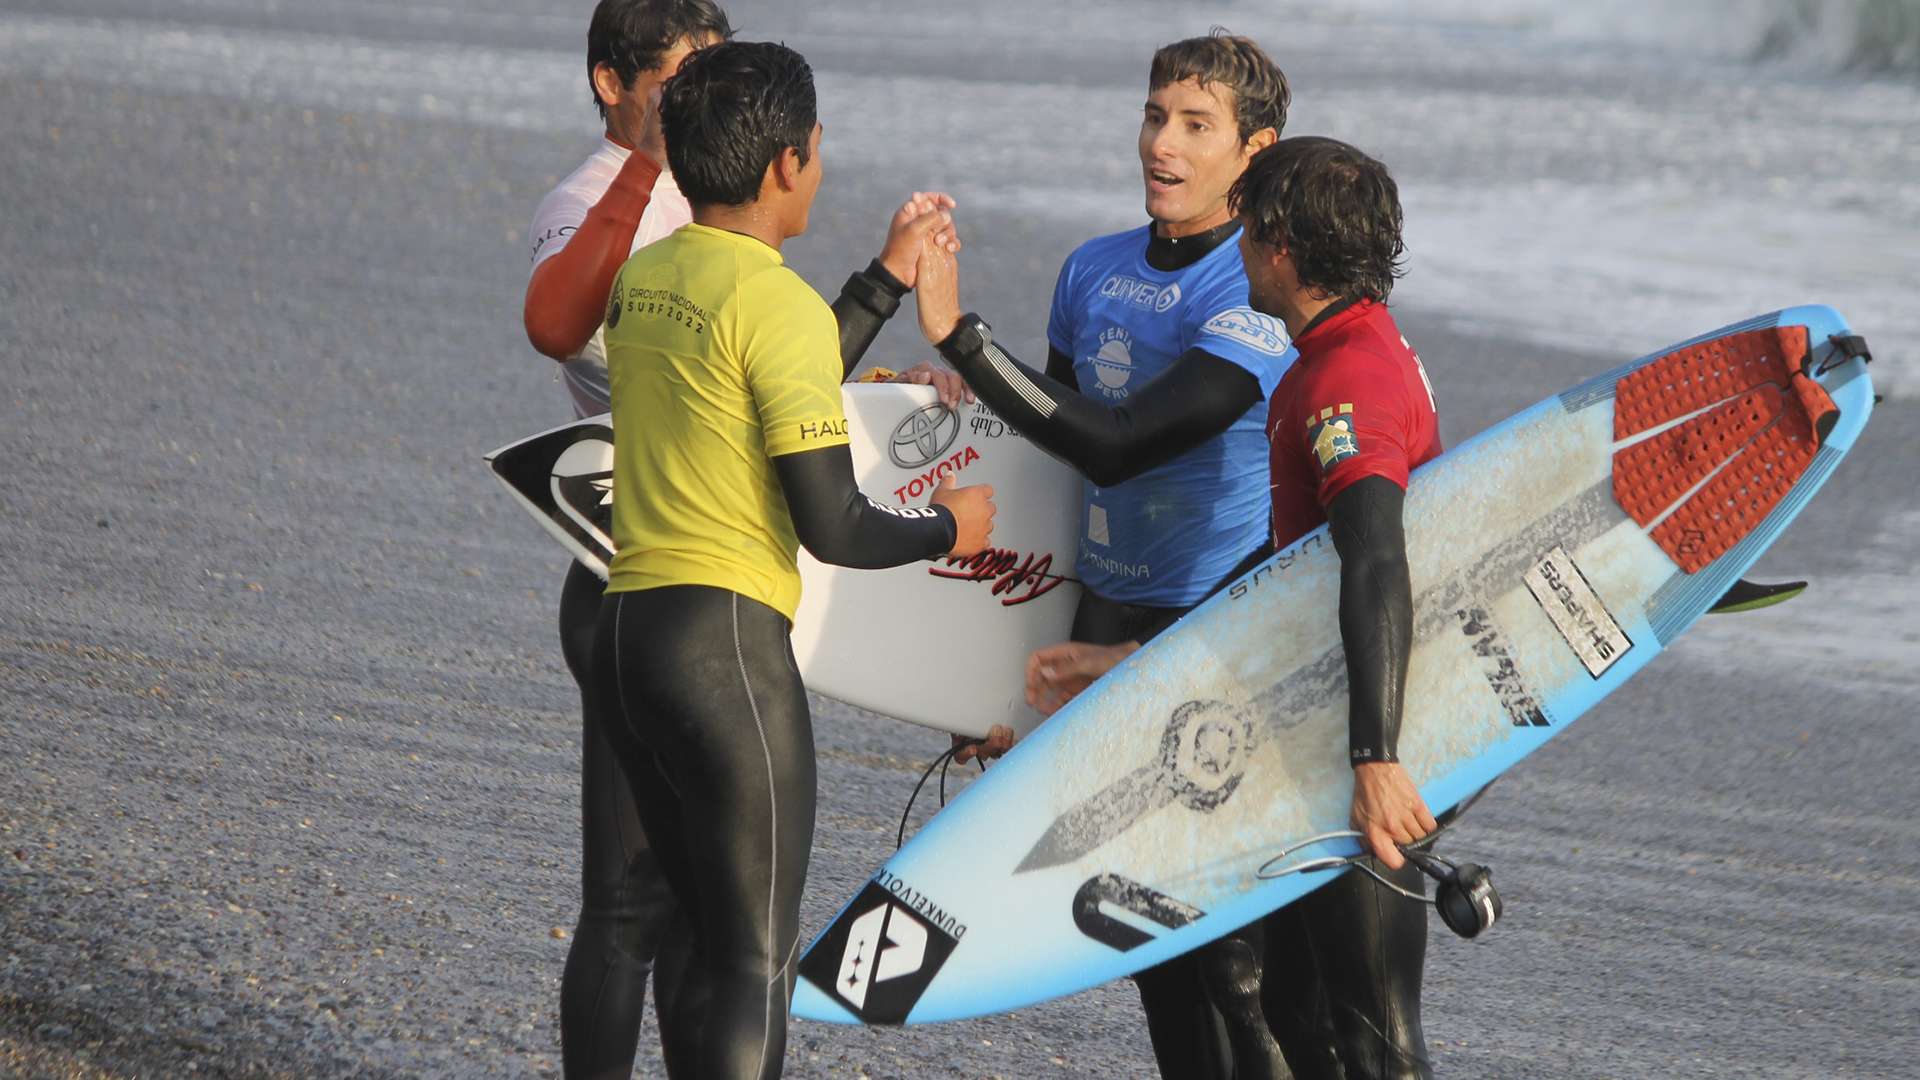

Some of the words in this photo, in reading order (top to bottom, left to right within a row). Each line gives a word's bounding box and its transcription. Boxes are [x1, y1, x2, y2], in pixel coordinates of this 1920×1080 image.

[629, 287, 667, 300] CIRCUITO
[669, 292, 707, 321] NACIONAL
[1094, 381, 1128, 398] PERU
[971, 416, 1004, 439] Club
[894, 446, 980, 505] TOYOTA
[1539, 560, 1616, 661] SHAPERS
[878, 868, 967, 939] DUNKELVOLK
